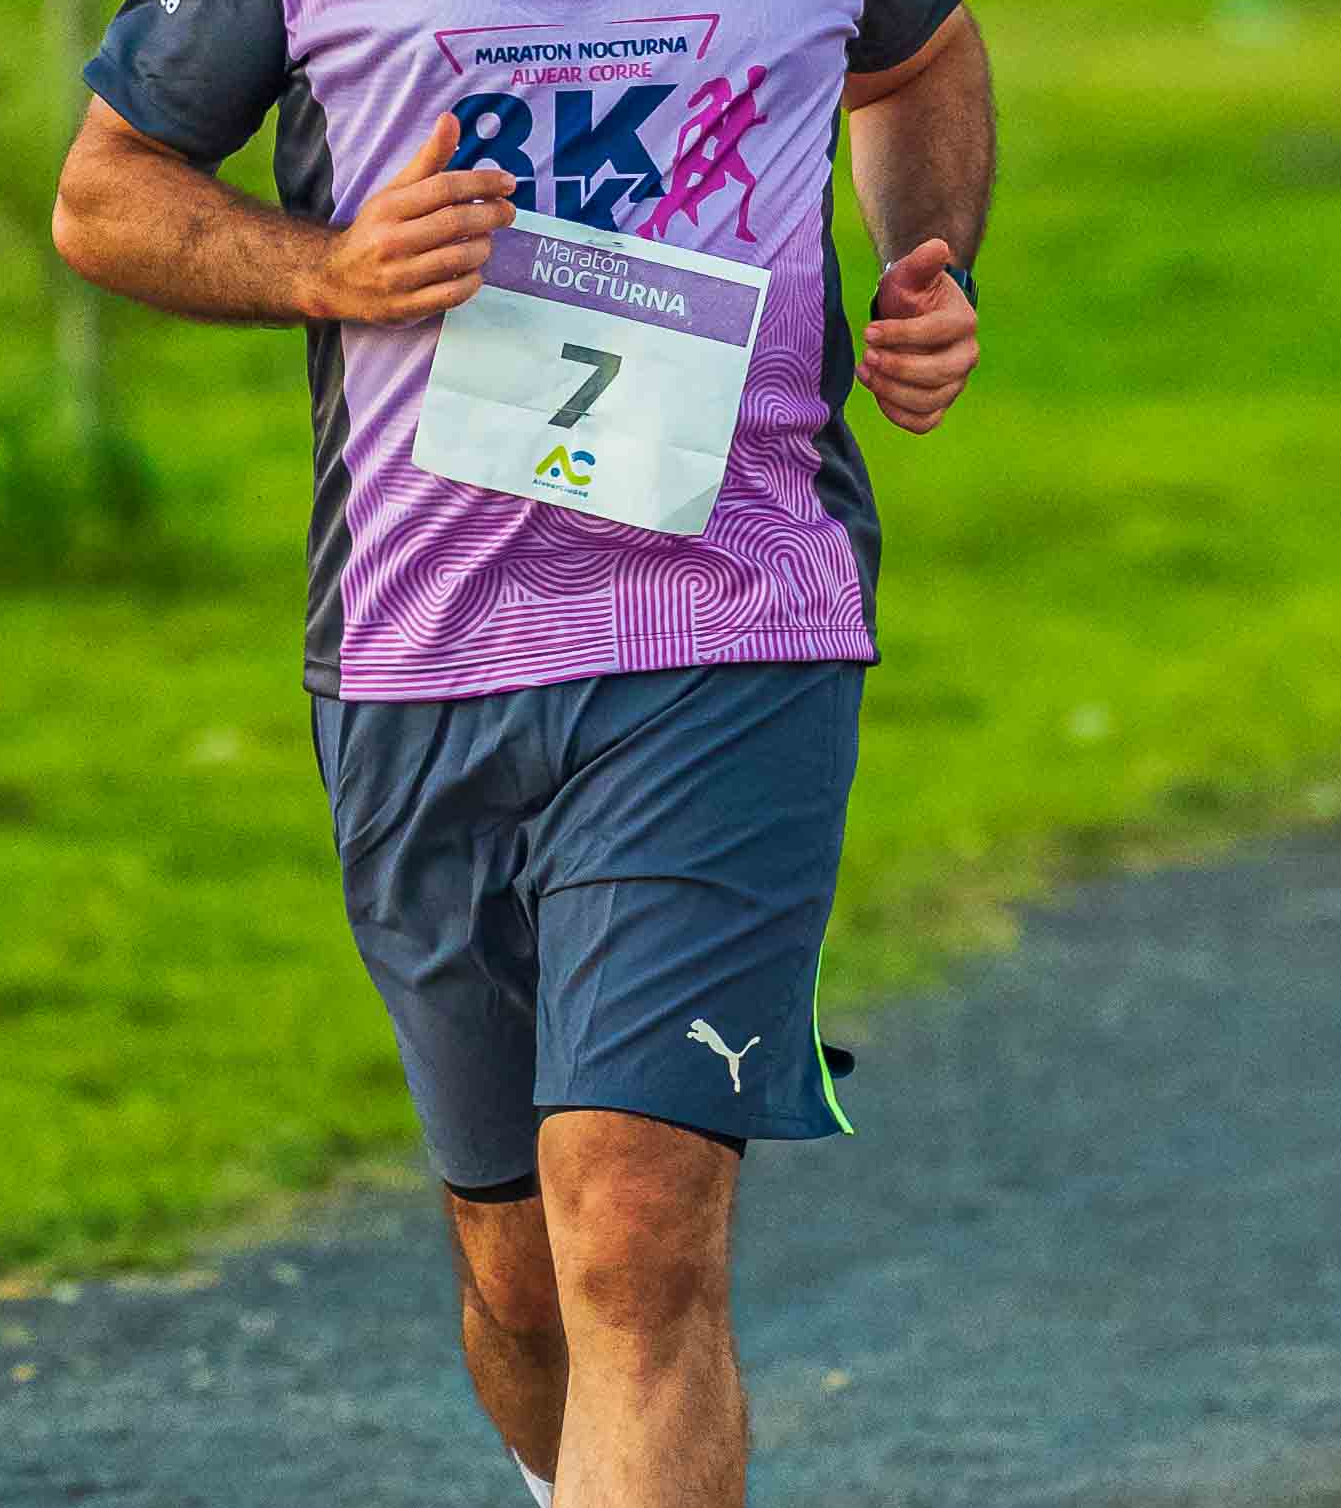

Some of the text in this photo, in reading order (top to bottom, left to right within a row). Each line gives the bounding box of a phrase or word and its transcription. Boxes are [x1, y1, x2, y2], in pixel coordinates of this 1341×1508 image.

[475, 36, 688, 65] MARATON NOCTURNA
[511, 62, 652, 85] ALVEAR CORRE
[447, 84, 678, 233] 8K
[535, 237, 629, 277] Maratón
[531, 260, 686, 317] NOCTURNA
[548, 342, 623, 429] 7
